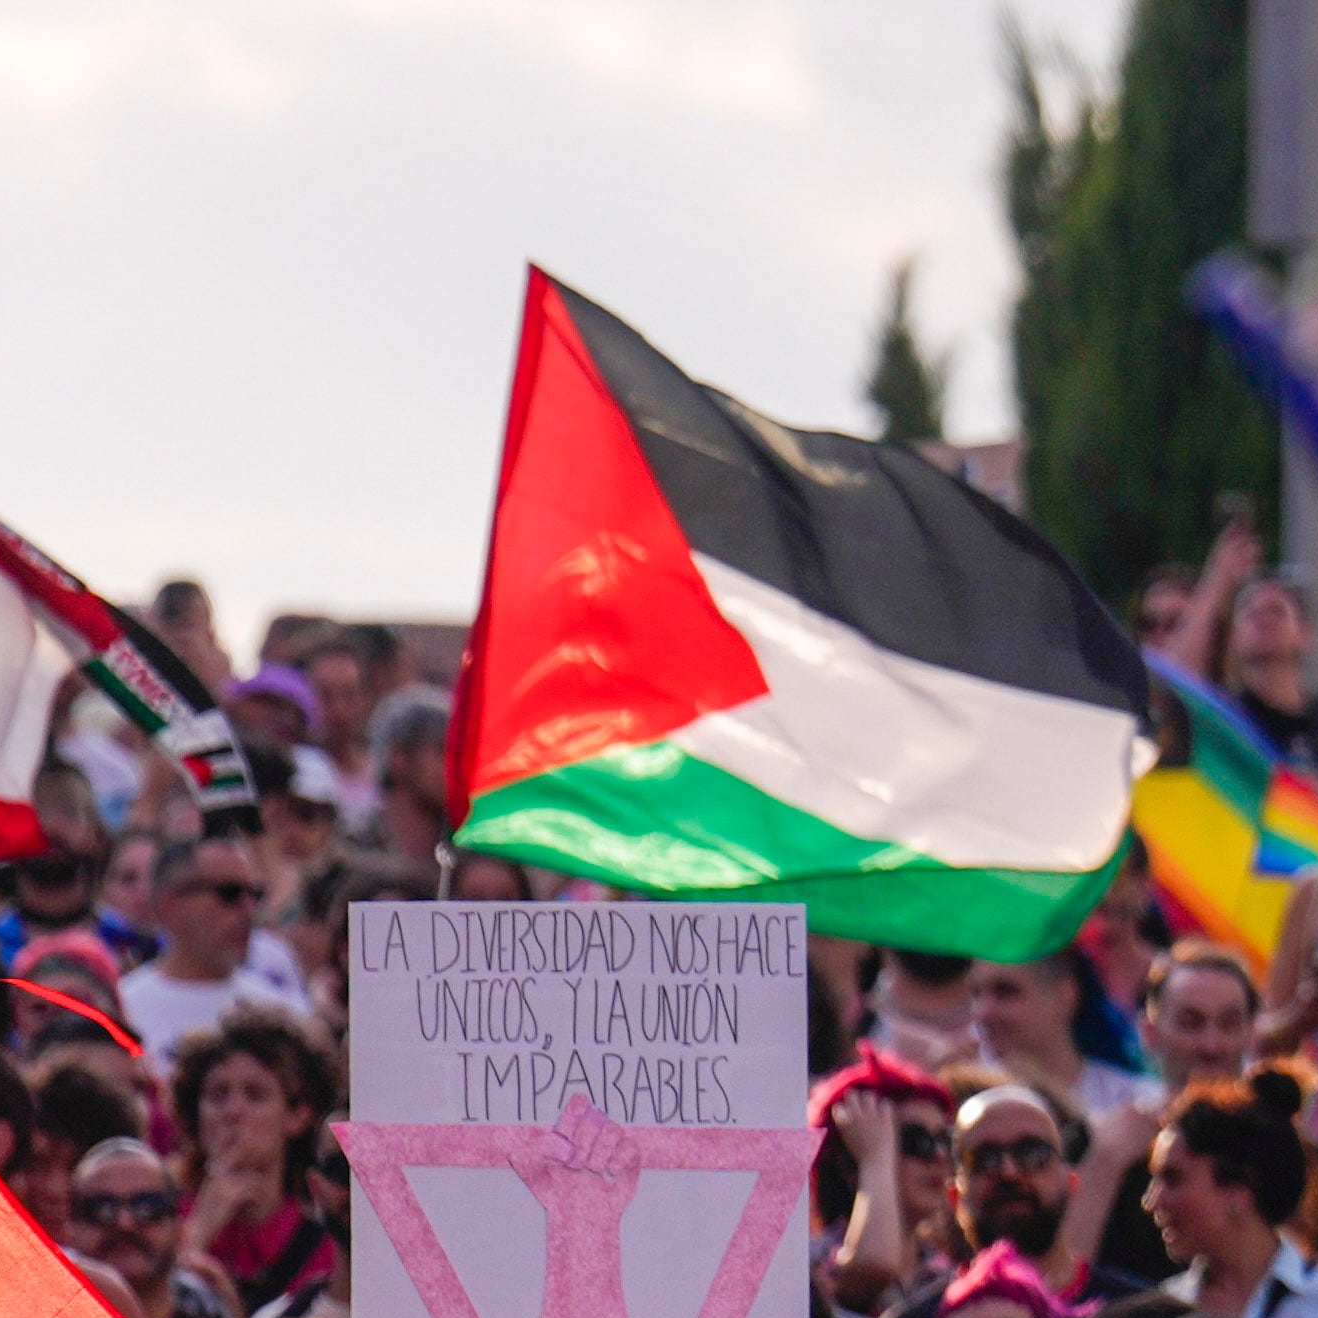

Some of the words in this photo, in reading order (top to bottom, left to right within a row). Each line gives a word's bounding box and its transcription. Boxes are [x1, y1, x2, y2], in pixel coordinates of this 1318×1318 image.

[361, 910, 410, 972] LA
[431, 909, 636, 975] DIVERSIDAD
[649, 912, 708, 975] NOS
[717, 914, 804, 978] HACE
[562, 977, 583, 1044] Y
[593, 979, 633, 1047] LA
[641, 977, 740, 1046] UNIÓN
[458, 1049, 738, 1125] IMPARABLES.
